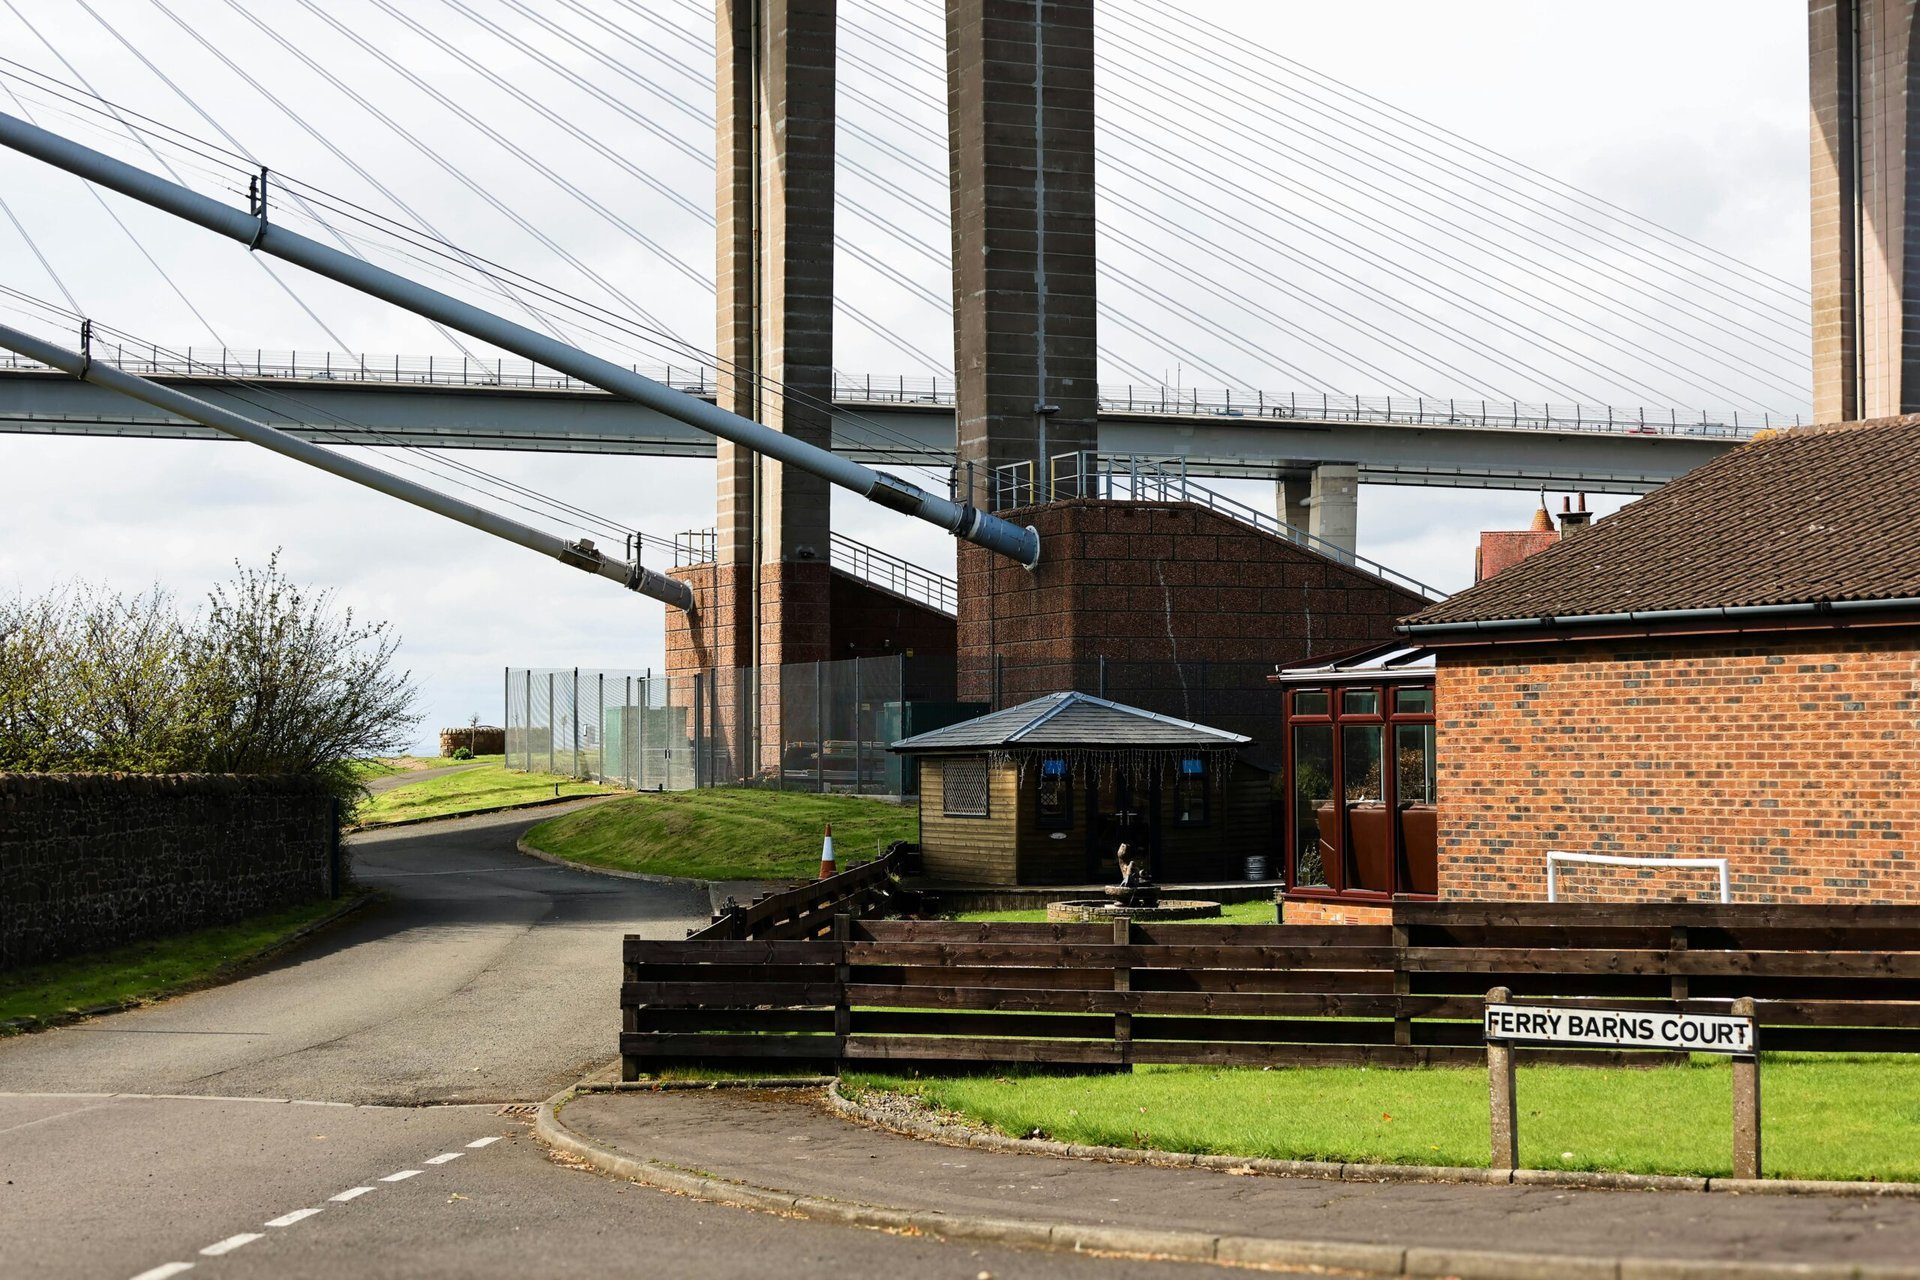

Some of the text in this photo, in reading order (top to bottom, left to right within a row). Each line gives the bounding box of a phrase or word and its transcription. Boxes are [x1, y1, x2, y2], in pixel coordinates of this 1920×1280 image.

[1488, 1011, 1749, 1044] FERRY BARNS COURT
